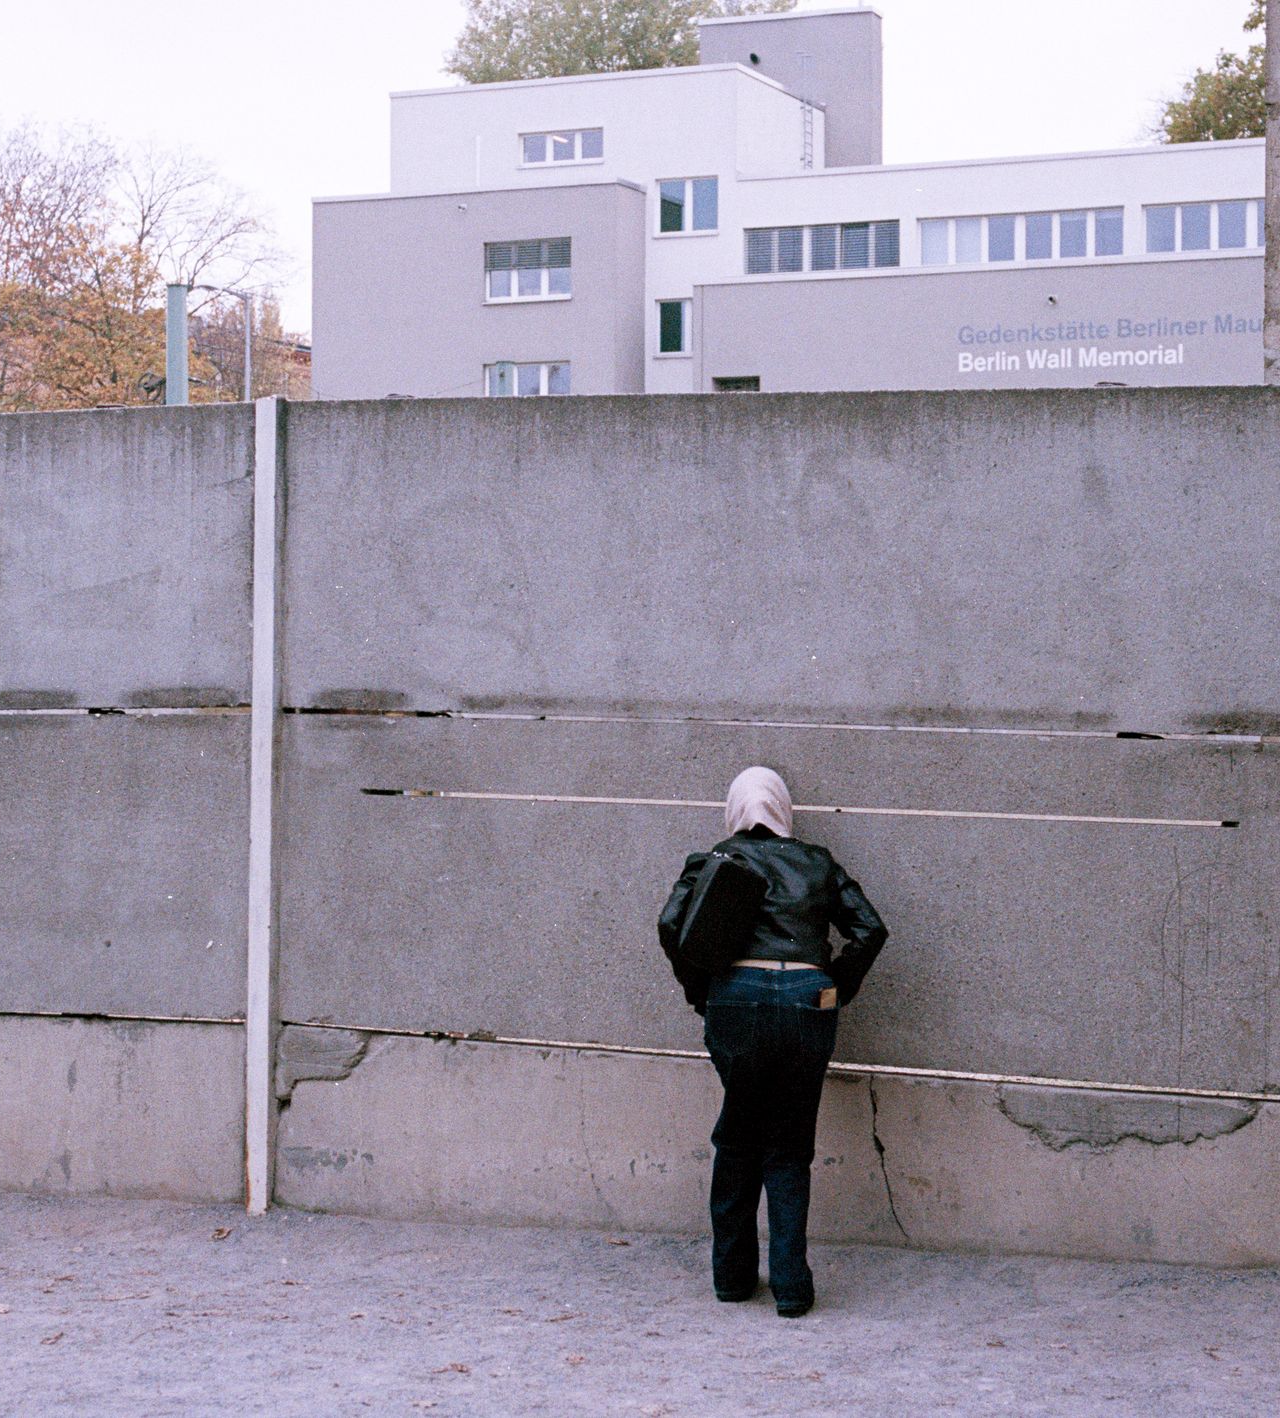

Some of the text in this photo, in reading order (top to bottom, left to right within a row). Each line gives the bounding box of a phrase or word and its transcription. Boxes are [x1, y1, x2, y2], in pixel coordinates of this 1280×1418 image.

[958, 321, 1109, 345] Gedenkstätte
[1117, 317, 1208, 338] Berliner
[958, 343, 1183, 372] Berlin Wall Memorial
